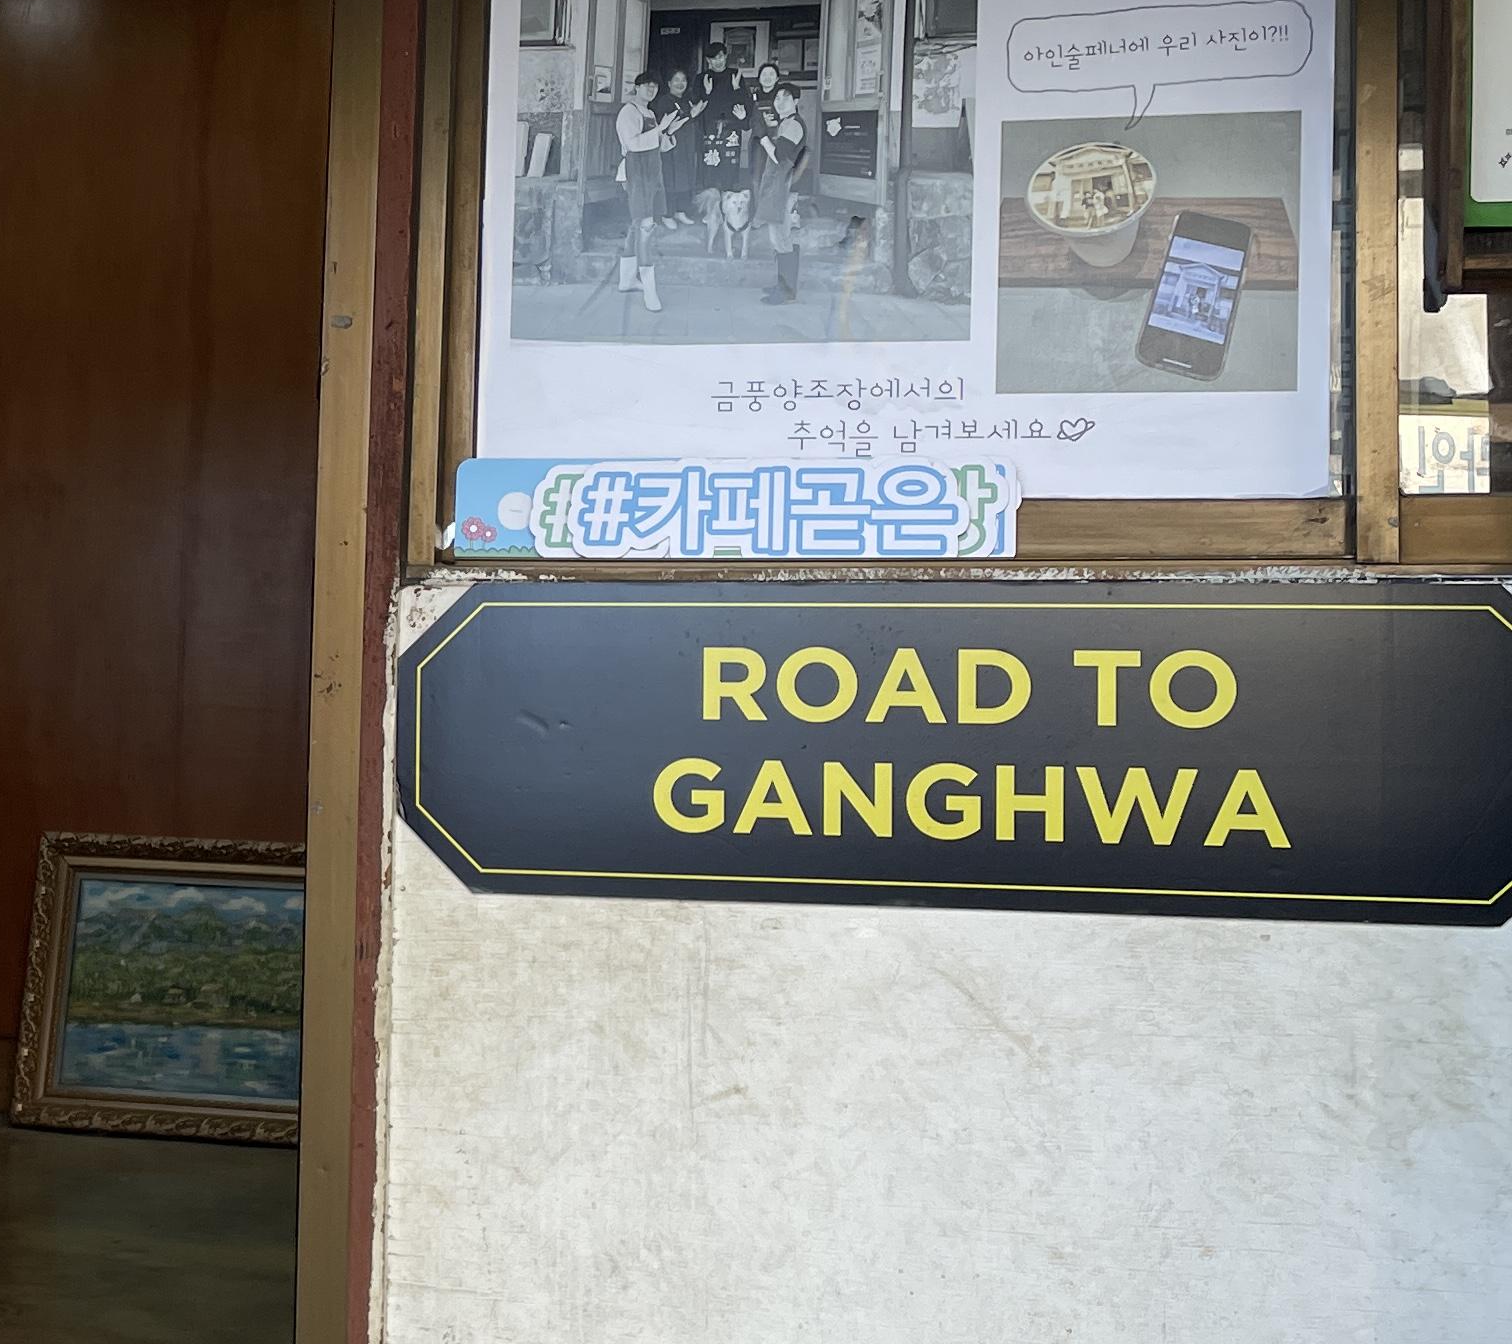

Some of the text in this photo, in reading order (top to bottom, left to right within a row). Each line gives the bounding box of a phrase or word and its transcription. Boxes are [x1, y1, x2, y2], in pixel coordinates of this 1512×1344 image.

[710, 378, 965, 413] 금풍양조장에서의
[788, 418, 1052, 455] 추억을 남겨보세요
[581, 466, 960, 556] #카페곧은
[701, 646, 1237, 729] ROAD TO
[653, 758, 1291, 850] GANGHWA
